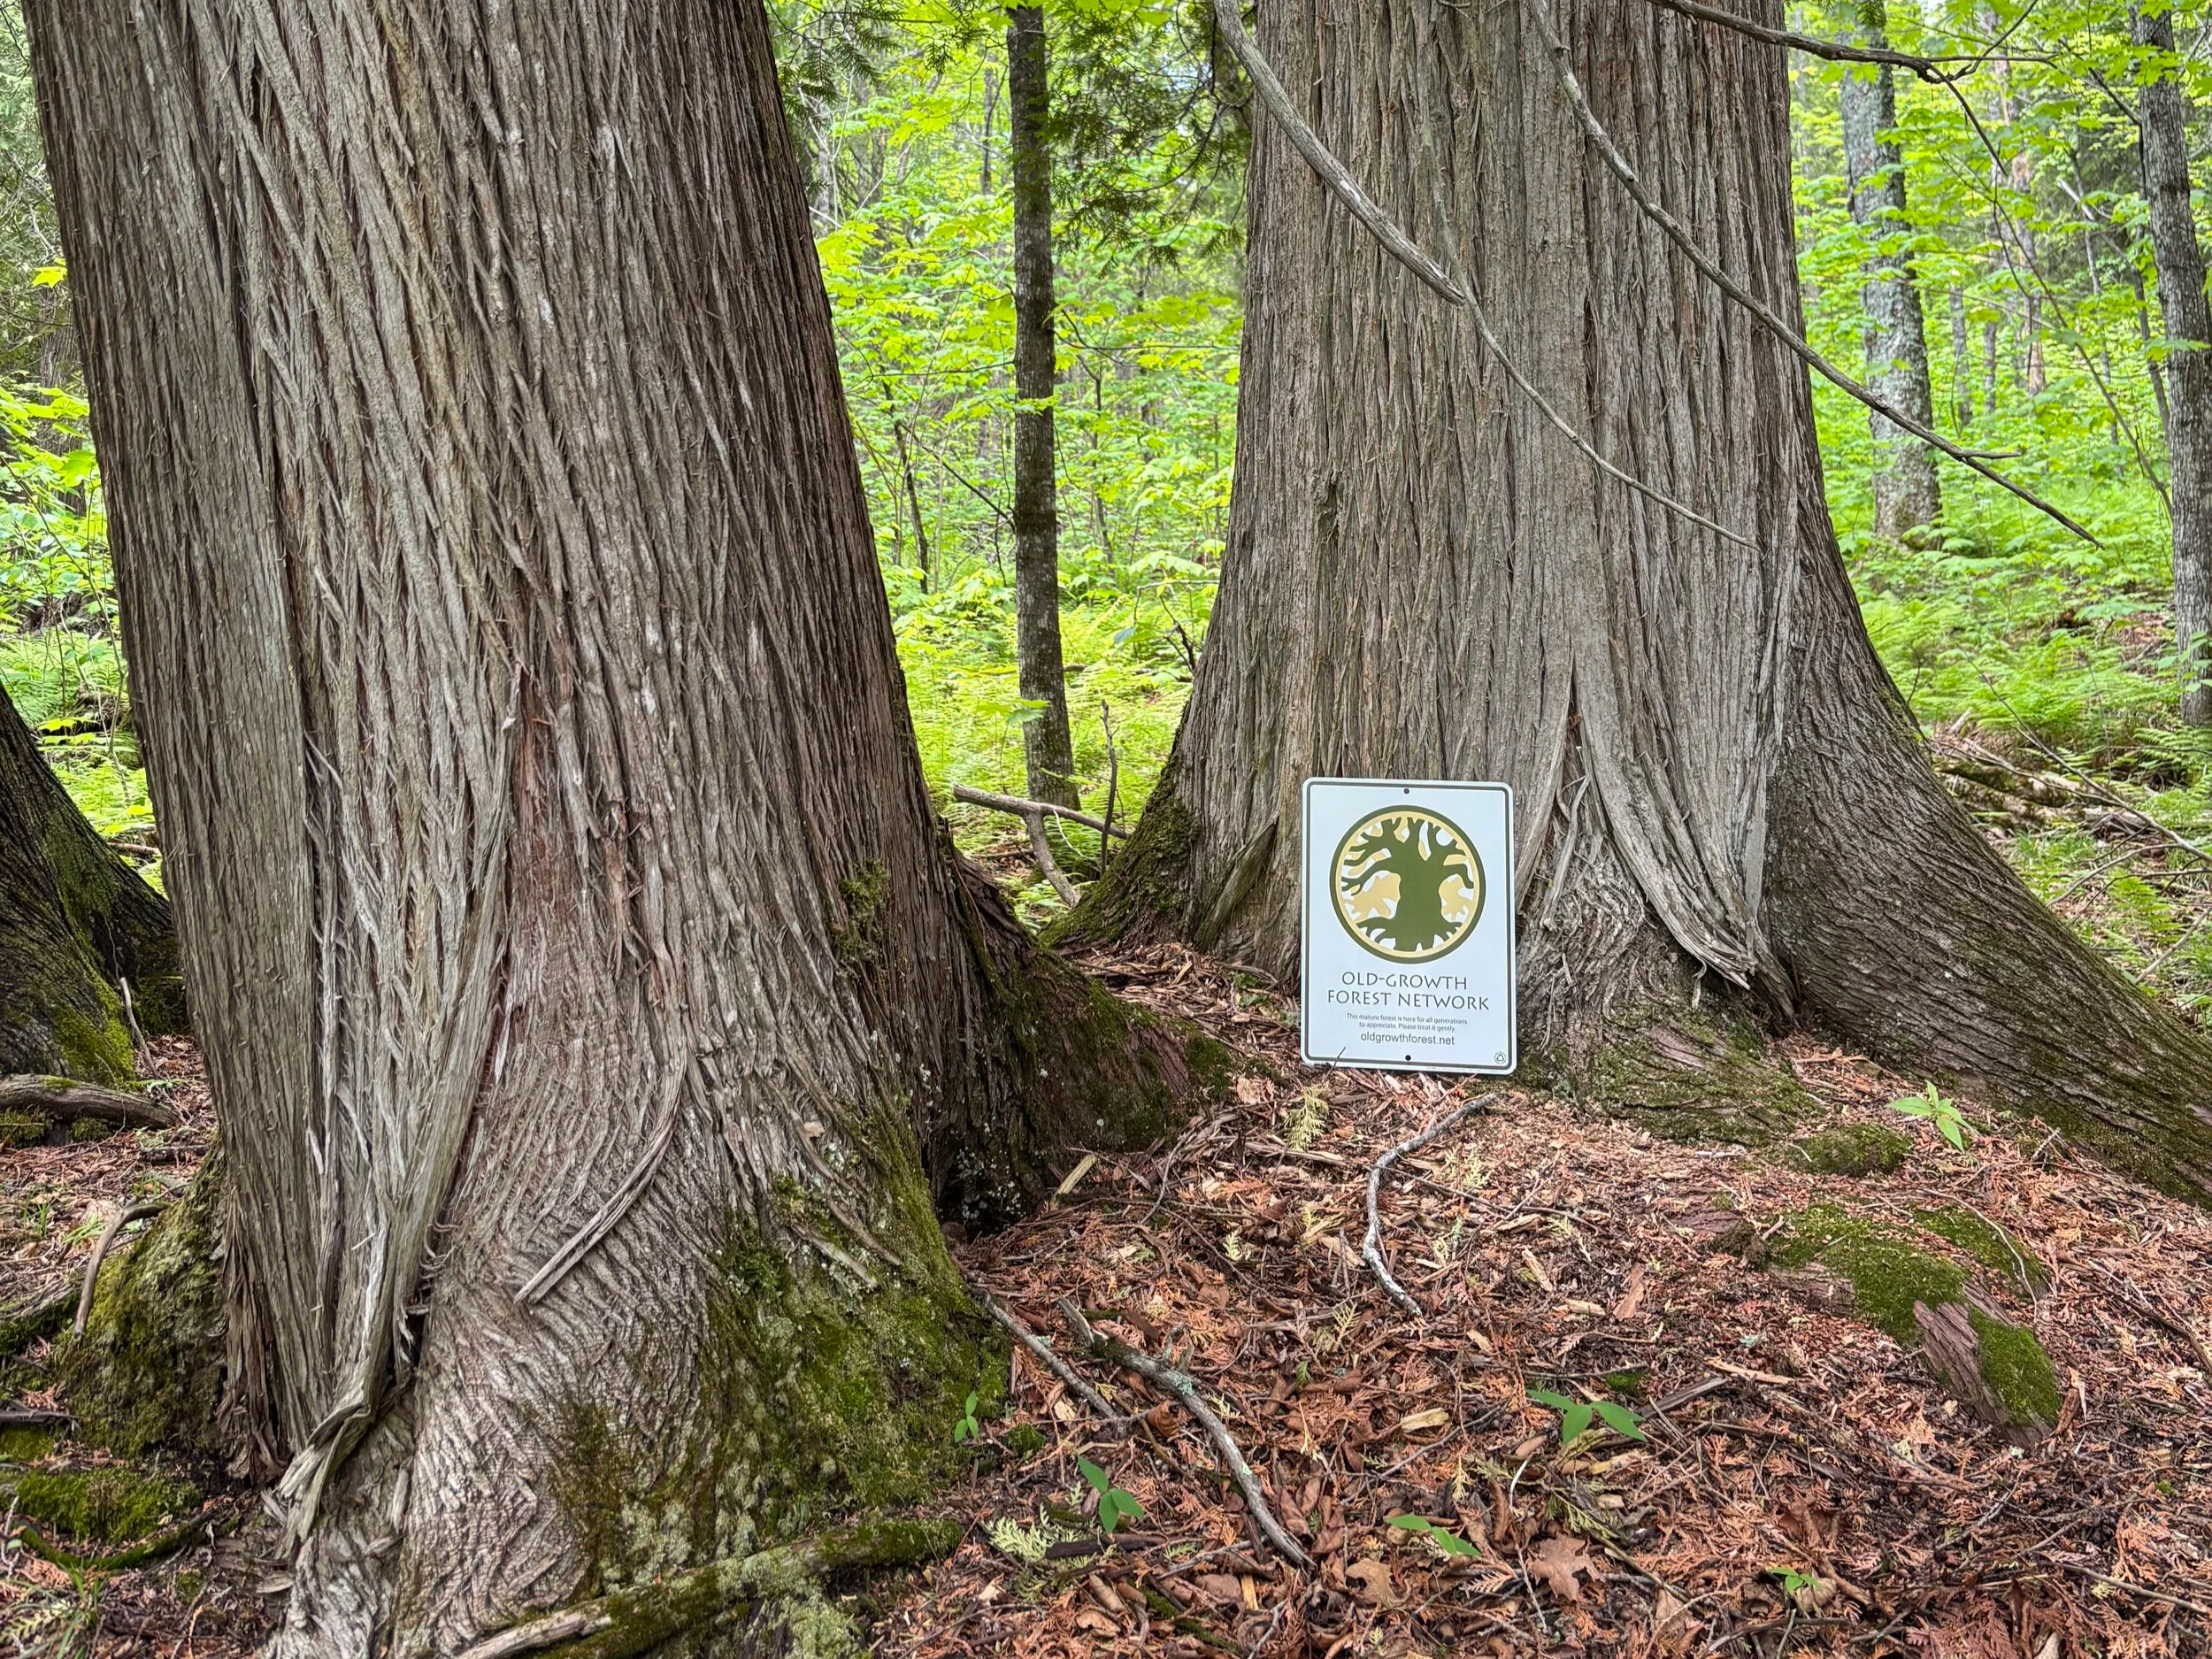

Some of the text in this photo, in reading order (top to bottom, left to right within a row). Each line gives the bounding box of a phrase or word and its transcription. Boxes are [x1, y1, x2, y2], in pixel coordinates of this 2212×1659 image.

[1341, 972, 1467, 990] OLD-GROWTH
[1328, 989, 1489, 1010] FOREST NETWORK
[1360, 1032, 1455, 1045] oldgrowthforest.net
